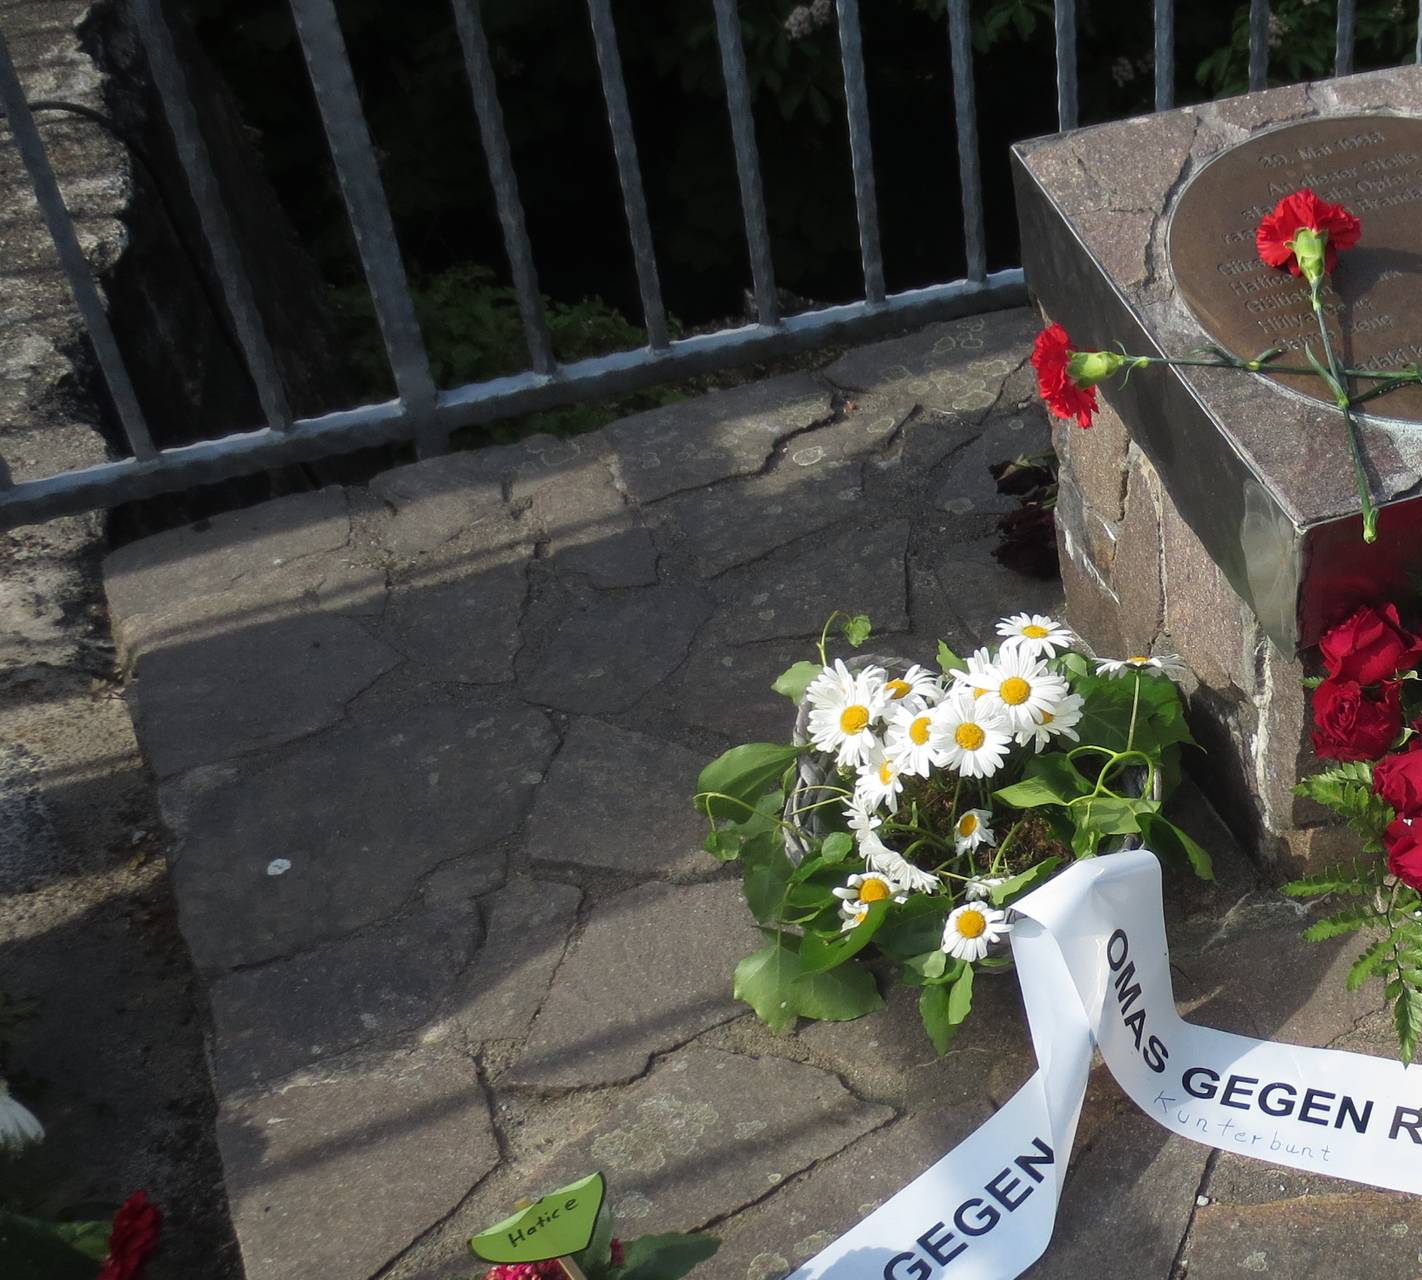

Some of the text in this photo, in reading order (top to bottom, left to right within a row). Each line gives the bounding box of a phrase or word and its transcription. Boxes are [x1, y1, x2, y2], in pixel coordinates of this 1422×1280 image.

[1296, 143, 1333, 161] Mai
[1266, 181, 1295, 196] An
[1356, 172, 1409, 193] Opfer
[1106, 928, 1169, 1074] OMAS
[1181, 1066, 1375, 1135] GEGEN
[1153, 1088, 1334, 1163] Kunterbunt
[507, 1196, 579, 1249] Hatice
[883, 1136, 1056, 1280] GEGEN
